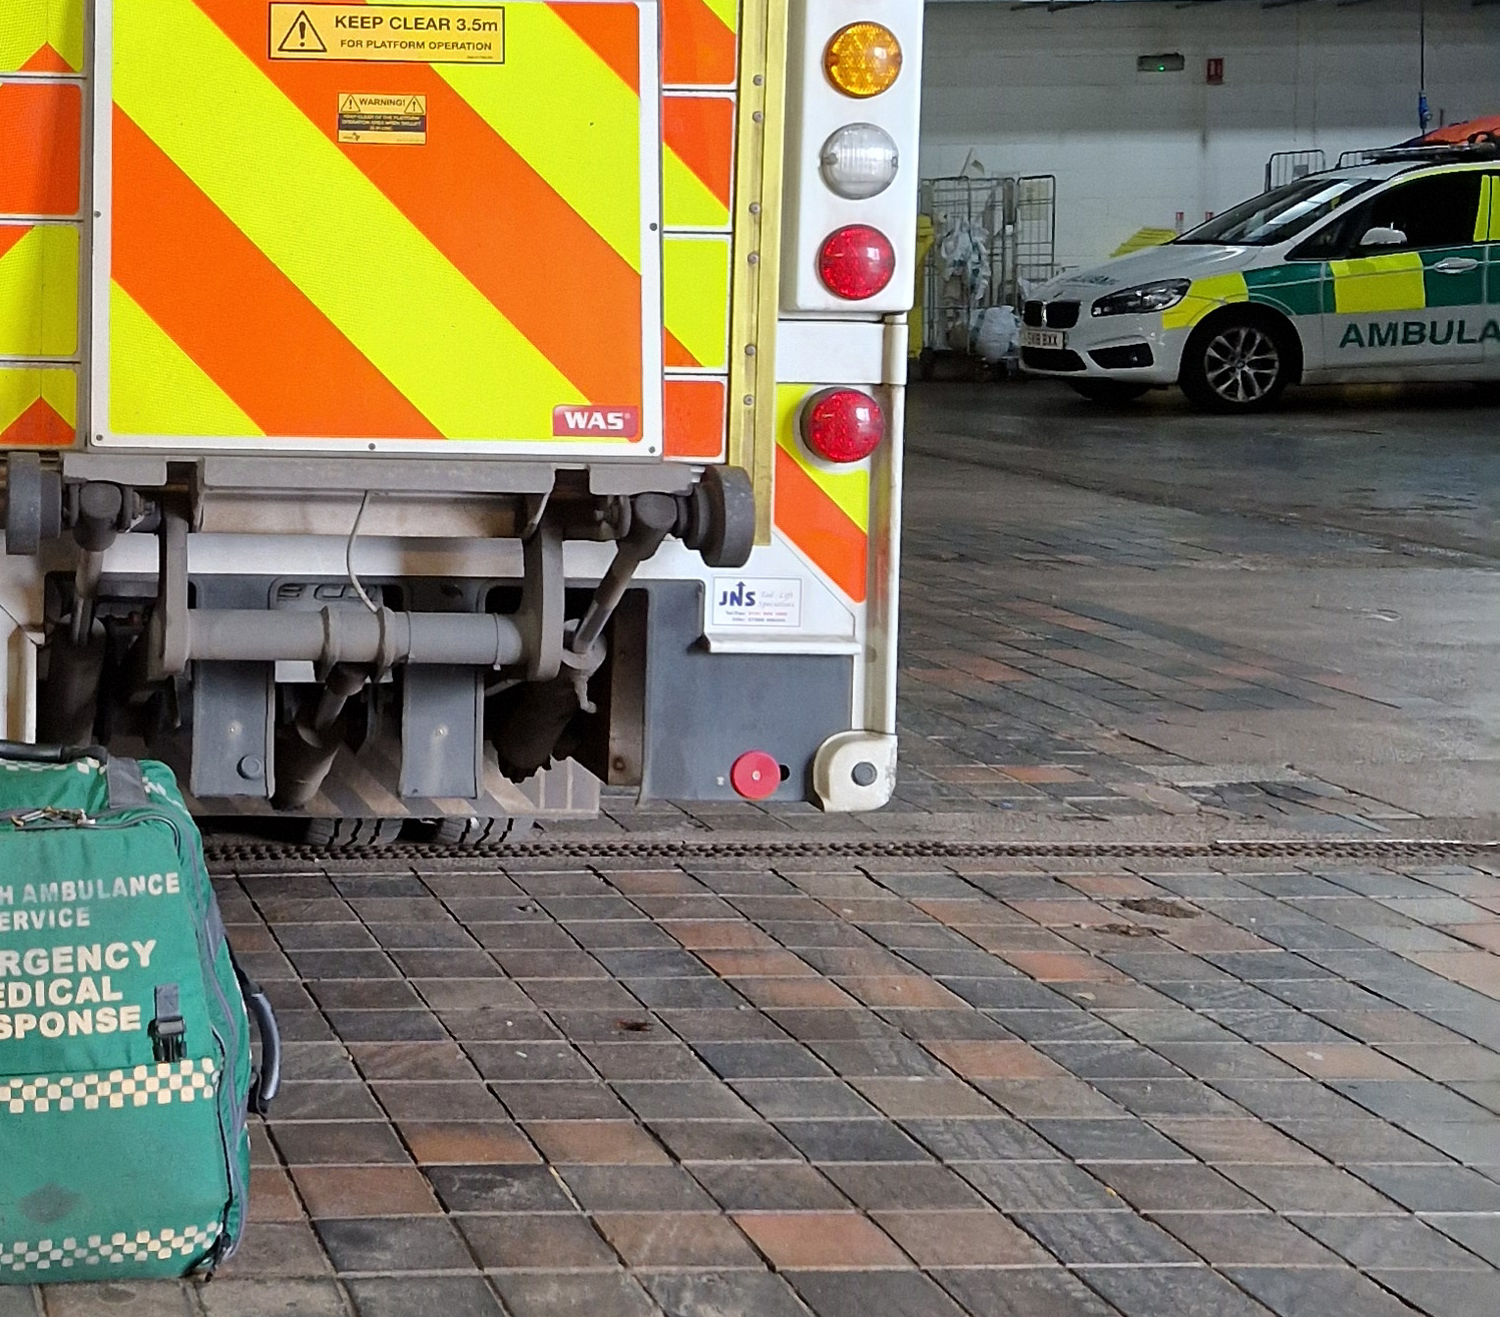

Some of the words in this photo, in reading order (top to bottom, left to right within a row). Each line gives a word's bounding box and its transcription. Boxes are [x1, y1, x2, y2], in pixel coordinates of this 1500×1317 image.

[334, 15, 383, 29] KEEP
[389, 16, 451, 31] CLEAR
[456, 18, 498, 32] 3.5m
[340, 39, 363, 48] FOR
[366, 39, 426, 50] PLATFORM
[428, 41, 492, 51] OPERATION
[1339, 319, 1500, 348] AMBULA
[564, 411, 624, 430] WAS
[718, 584, 756, 606] JNS
[22, 872, 180, 904] AMBULANCE
